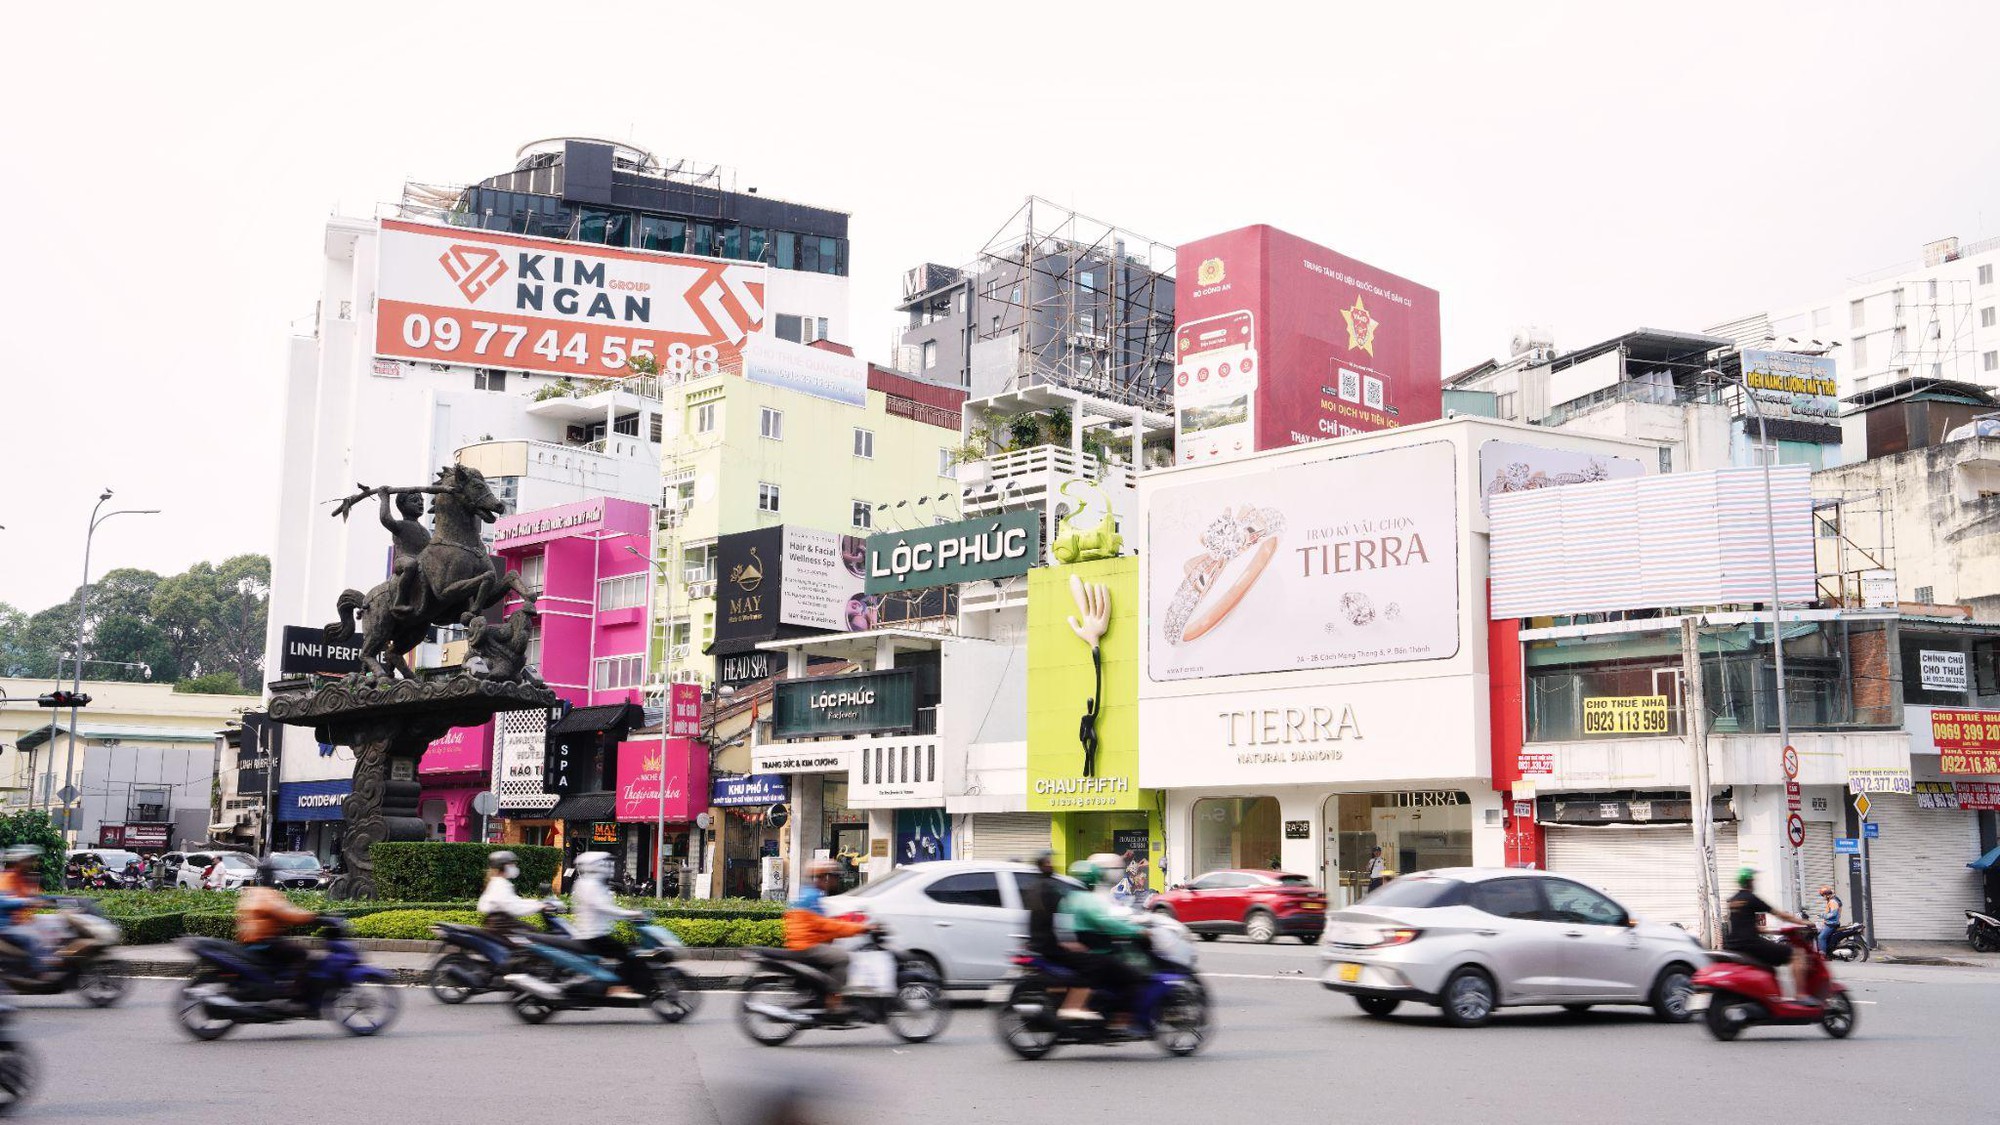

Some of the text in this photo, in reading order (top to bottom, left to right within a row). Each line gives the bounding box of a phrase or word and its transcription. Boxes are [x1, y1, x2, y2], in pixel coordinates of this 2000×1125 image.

[518, 252, 606, 288] KIM
[609, 279, 651, 293] GROUP
[516, 283, 651, 323] NGAN
[402, 313, 720, 376] 09 77 44 55 88
[1306, 527, 1334, 541] TRAO
[1379, 516, 1415, 531] CHỌN
[789, 541, 836, 557] Hair & Facial
[871, 522, 1027, 582] LỘC PHÚC
[1295, 532, 1430, 578] TIERRA
[789, 552, 835, 569] Wellness Spa
[729, 595, 762, 615] MAY
[290, 642, 387, 664] LINH PERFE
[1922, 653, 1964, 664] CHÍNH CHỦ
[723, 653, 769, 681] HEAD SPA
[1923, 665, 1965, 676] CHO THUÊ
[811, 685, 875, 711] LỘC PHÚC
[1586, 698, 1666, 709] CHO THUÊ NHÀ
[1219, 703, 1364, 747] TIERRA
[1586, 709, 1666, 732] 0923 113 598
[1932, 712, 1953, 721] CHO
[1955, 712, 1981, 722] THUÊ
[1933, 722, 2000, 741] 0969 399 20
[516, 751, 545, 760] HOTE
[762, 760, 782, 770] TRANG
[783, 757, 796, 769] SỨC
[1237, 749, 1343, 765] NATURAL DIAMOND
[1941, 755, 2000, 774] 0922.16.36.
[728, 783, 745, 796] KHU
[745, 779, 762, 794] PHỐ
[763, 783, 769, 793] 4
[1035, 776, 1129, 795] CHAUTFIFTH
[1397, 791, 1460, 808] TIERRA
[1286, 823, 1309, 832] 2A-2B
